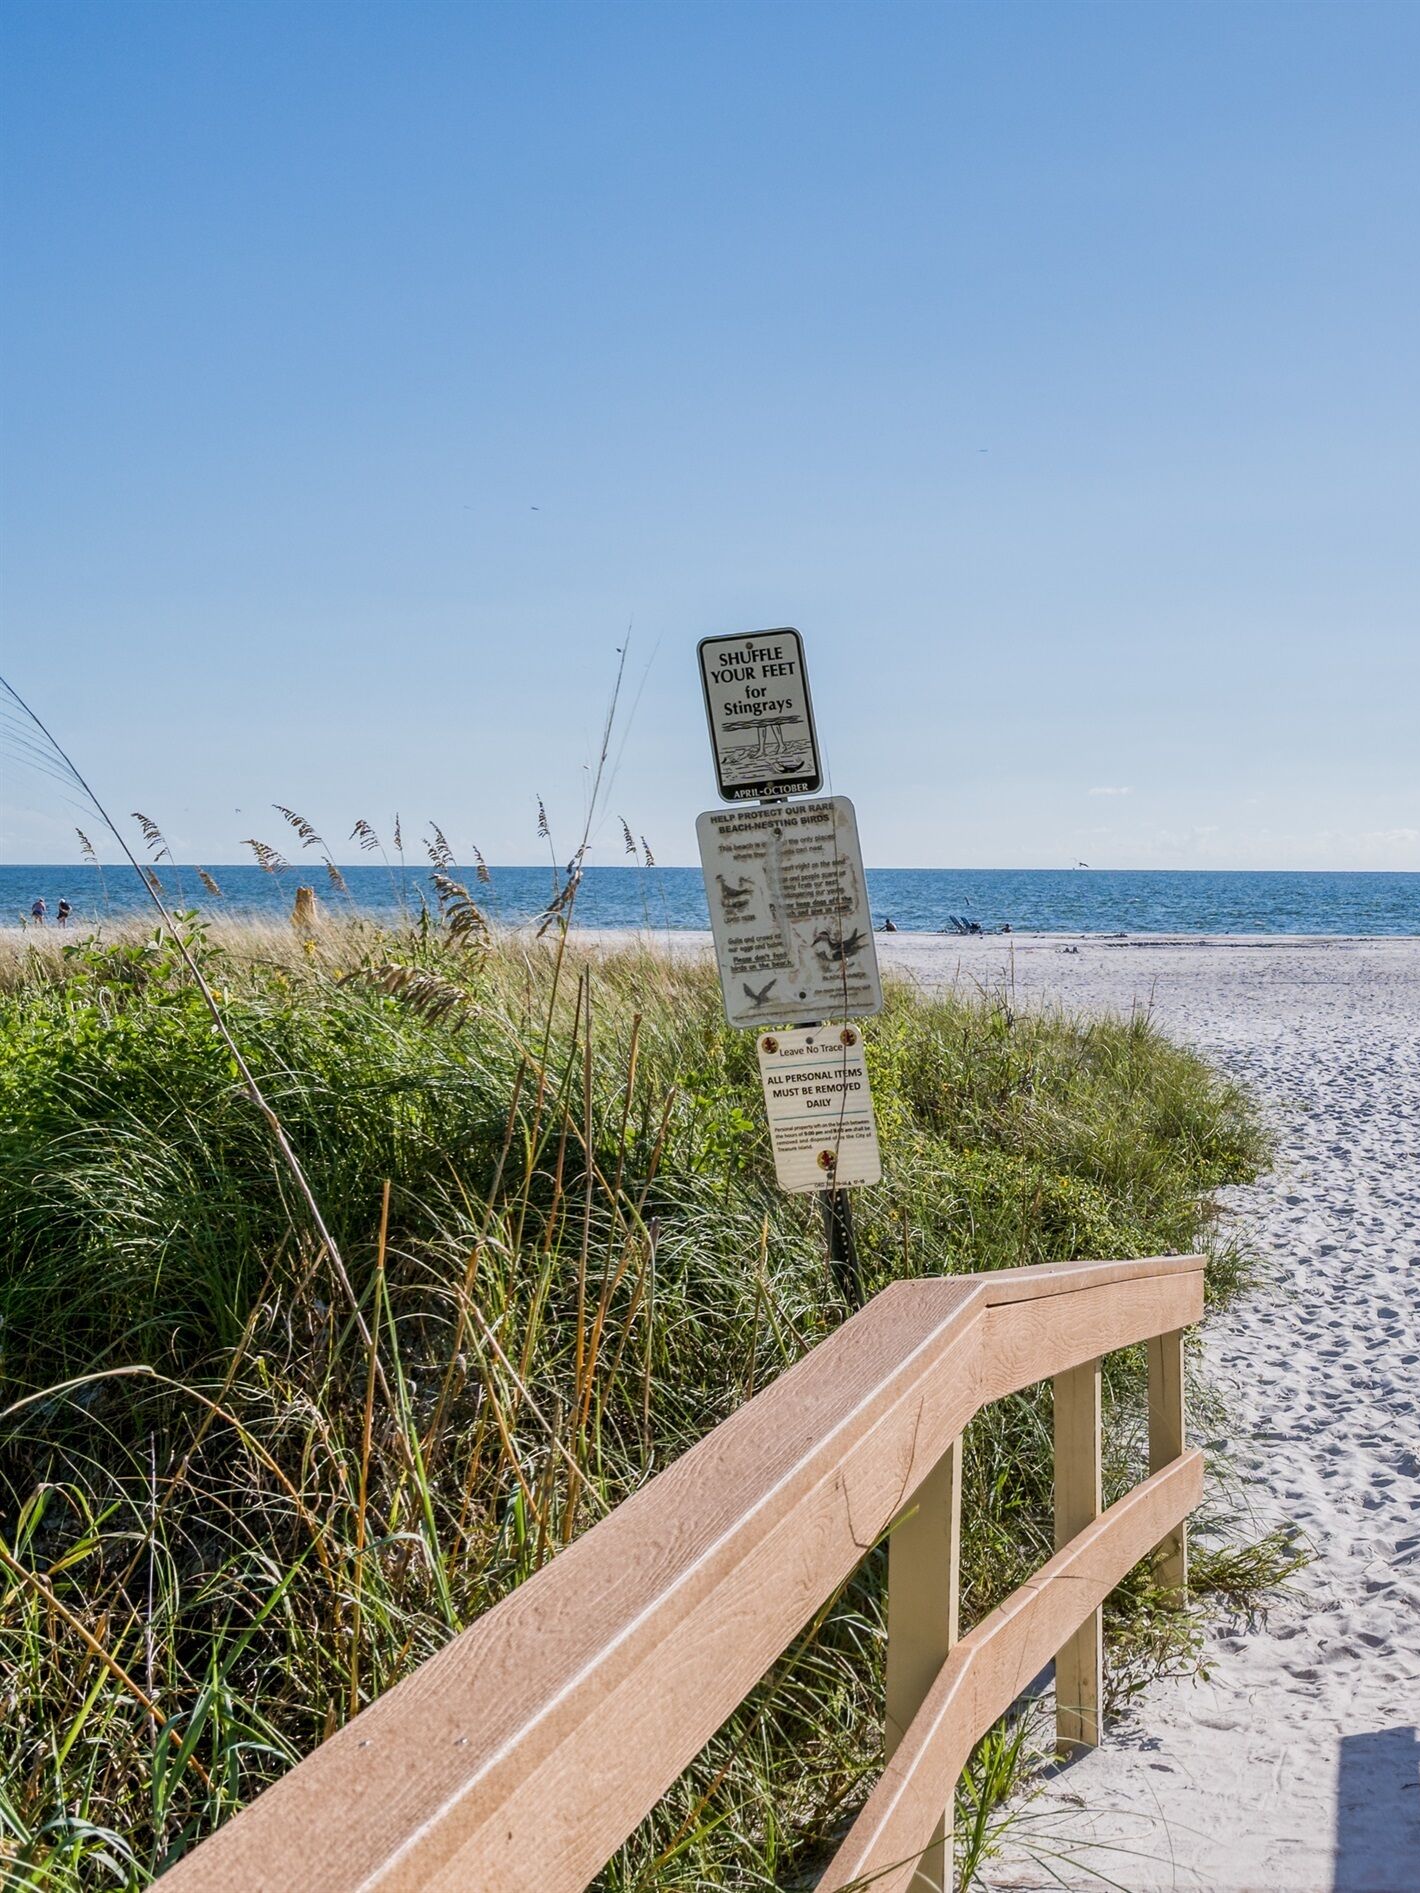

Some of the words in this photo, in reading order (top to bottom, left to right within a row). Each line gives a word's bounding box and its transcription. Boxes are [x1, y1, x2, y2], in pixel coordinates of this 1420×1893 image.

[719, 646, 784, 667] SHUFFLE
[711, 667, 756, 684] YOUR
[762, 662, 796, 678] FEET
[745, 685, 767, 699] for
[724, 698, 793, 716] Stingrays
[733, 784, 809, 798] APRIL-OCTOBER
[710, 813, 736, 824] HELP
[738, 808, 783, 821] PROTECT
[785, 805, 806, 816] OUR
[808, 802, 835, 812] RARE
[718, 819, 798, 834] BEACH-NESTING
[800, 814, 830, 825] BIRDS
[779, 1047, 805, 1057] Leave
[806, 1045, 819, 1054] No
[821, 1043, 844, 1053] Trace
[767, 1074, 785, 1085] ALL
[785, 1070, 833, 1084] PERSONAL
[834, 1068, 863, 1078] ITEMS
[772, 1087, 800, 1098] MUST
[802, 1085, 814, 1095] BE
[815, 1082, 861, 1095] REMOVED
[806, 1098, 832, 1109] DAILY
